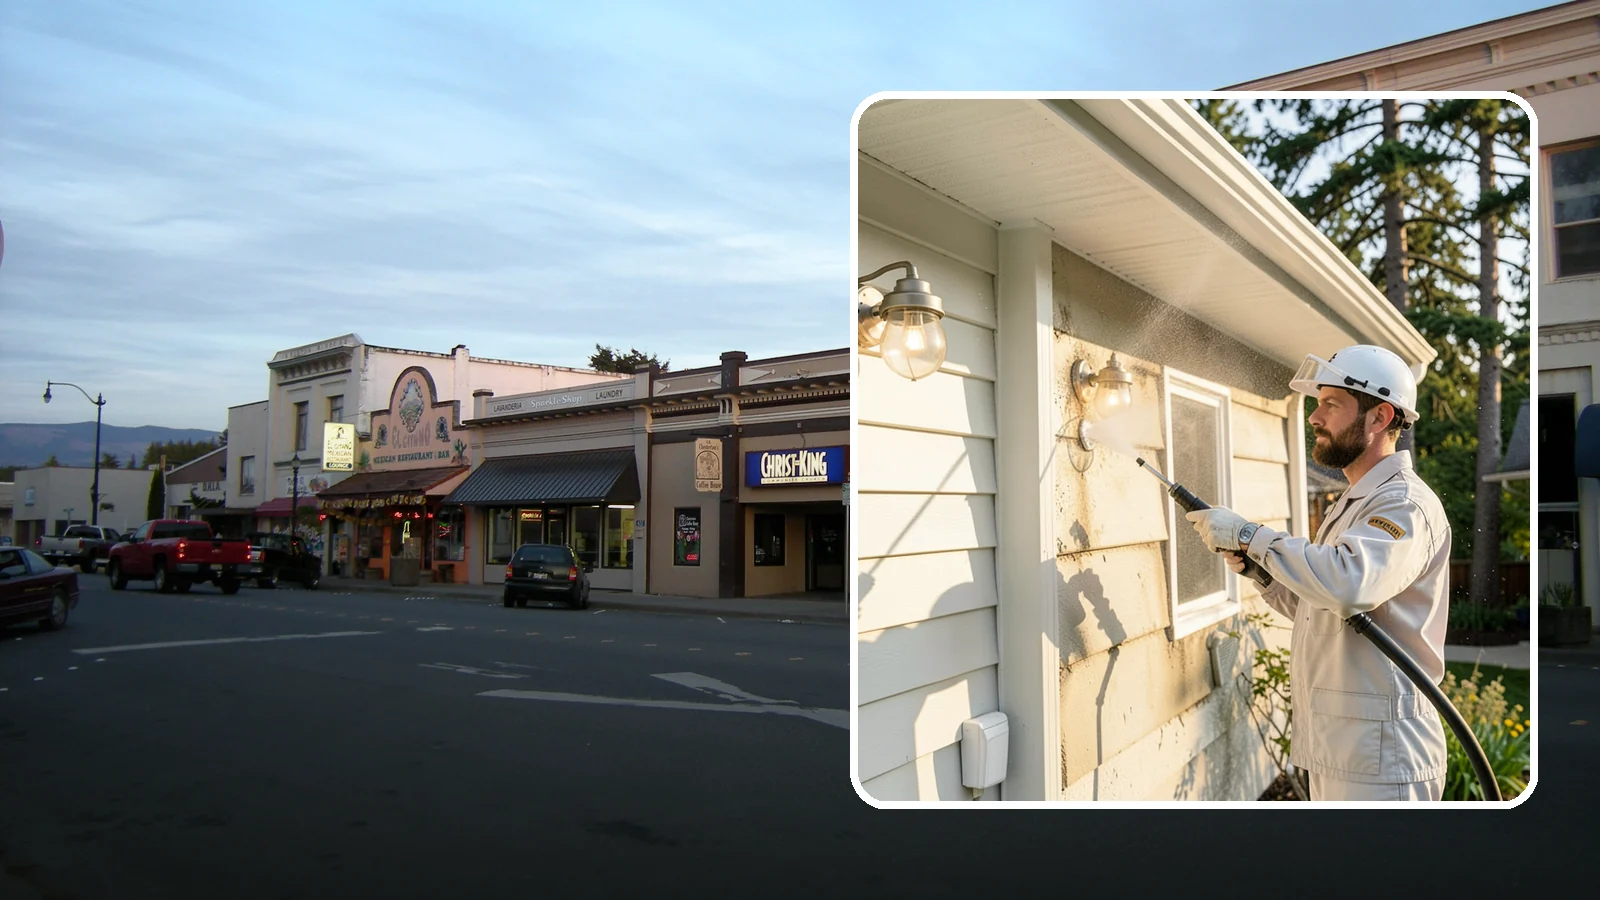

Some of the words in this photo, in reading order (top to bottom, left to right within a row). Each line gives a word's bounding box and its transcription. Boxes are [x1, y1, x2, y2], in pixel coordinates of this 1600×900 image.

[595, 389, 623, 400] LAUNDRY
[493, 402, 522, 413] LAVANDERIA
[531, 397, 560, 409] Sparkle
[562, 395, 582, 406] Shop
[374, 455, 395, 464] MEXICAN
[398, 451, 433, 462] RESTAURANT
[438, 450, 450, 459] BAR
[761, 452, 798, 478] CHRIST
[799, 450, 827, 476] KING
